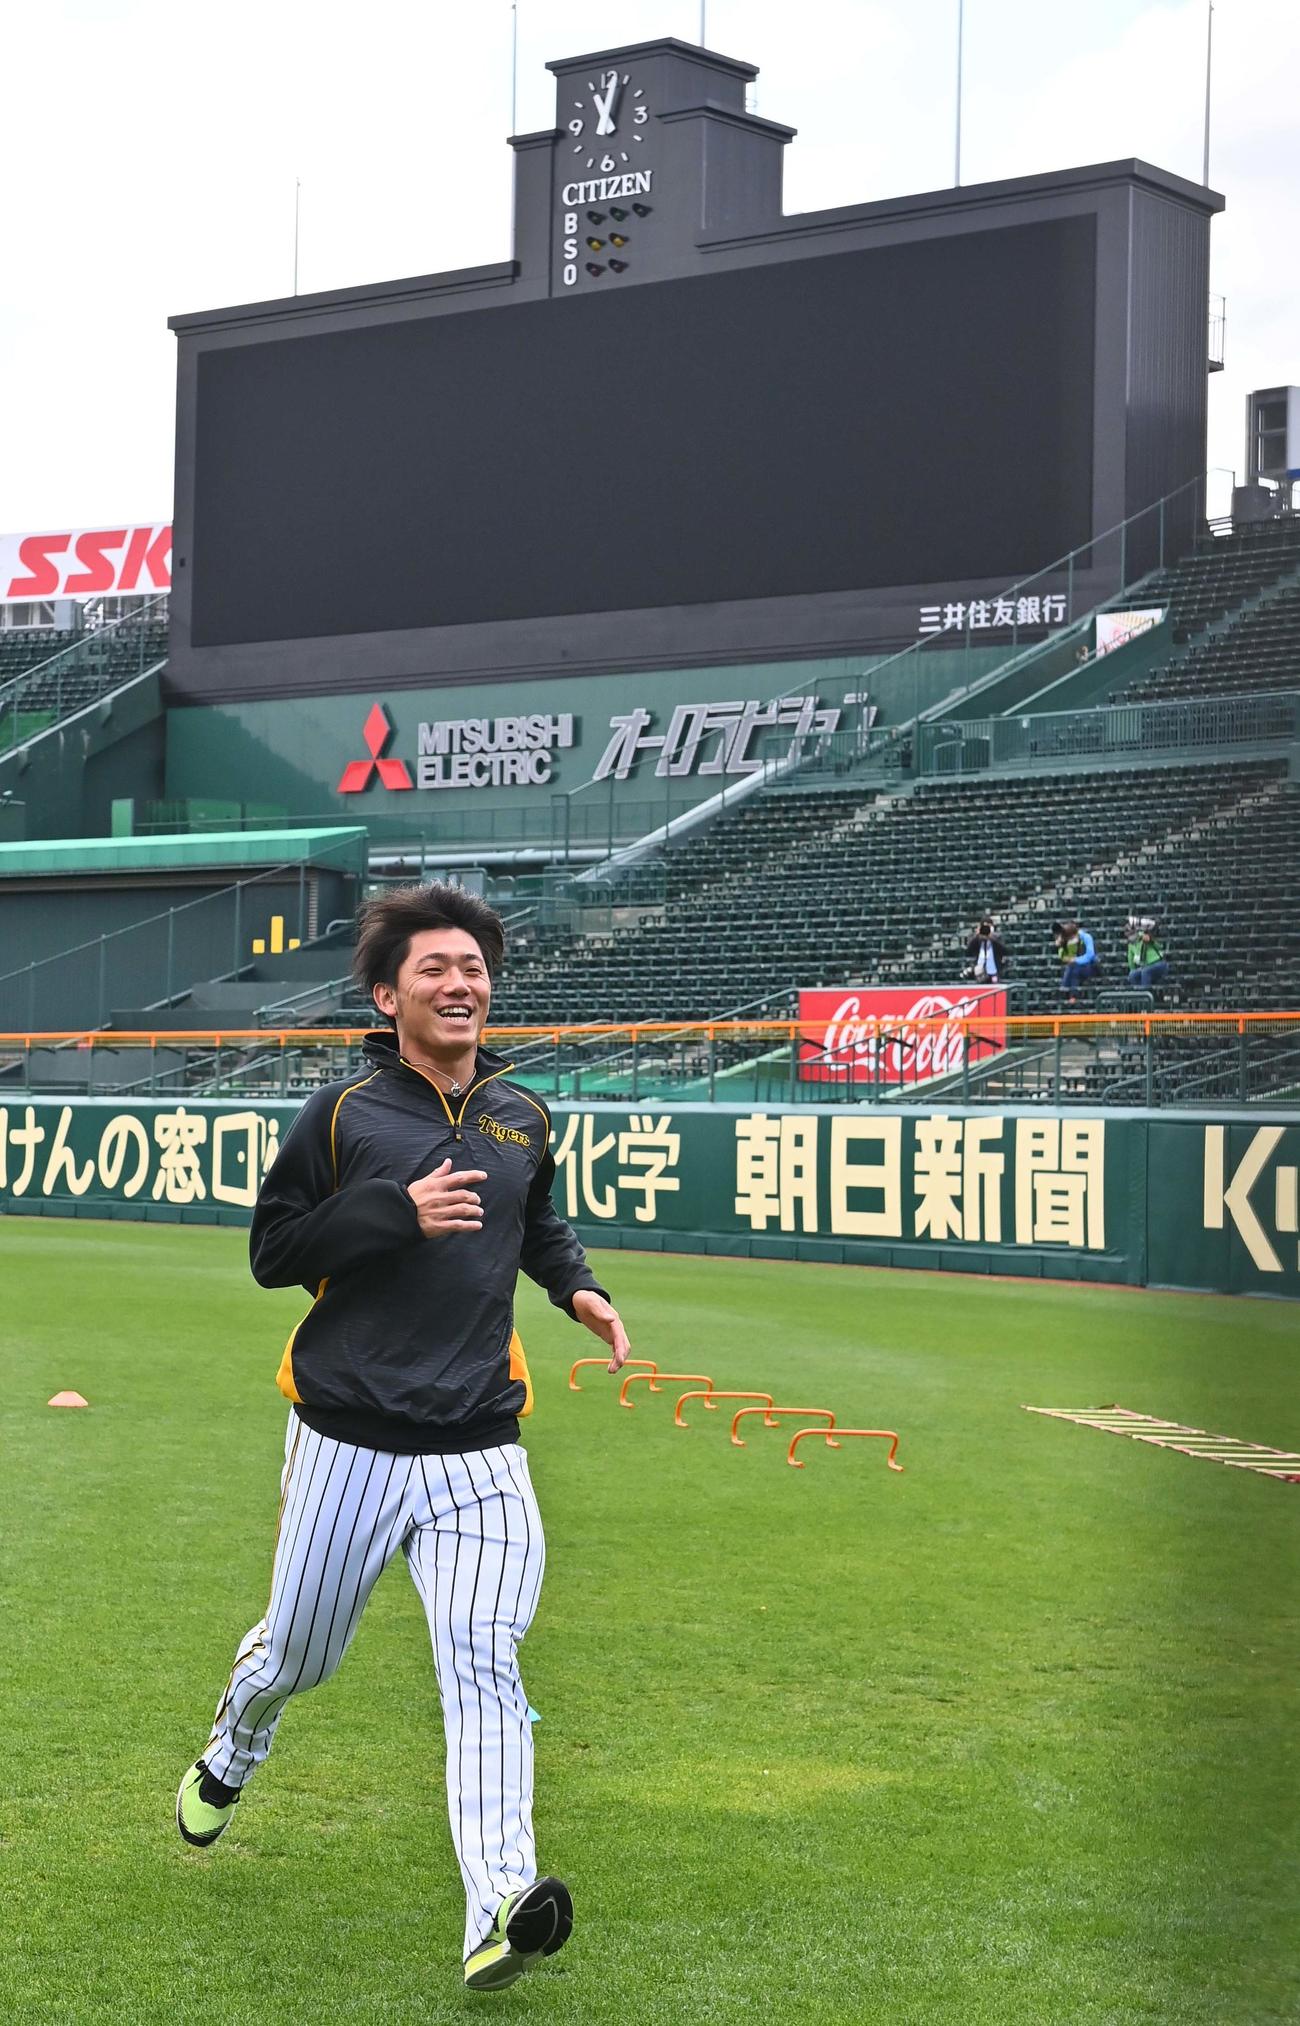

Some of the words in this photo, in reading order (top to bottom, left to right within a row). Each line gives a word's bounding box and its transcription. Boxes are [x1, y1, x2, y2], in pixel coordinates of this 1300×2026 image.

[568, 119, 584, 136] 9
[633, 106, 648, 124] 3
[600, 155, 615, 172] 6
[562, 171, 652, 206] CITIZEN
[564, 213, 578, 234] B
[563, 239, 578, 260] S
[6, 526, 173, 597] SSK
[918, 594, 1067, 633] 三井住友銀行
[417, 713, 573, 756] MITSUBISHI
[417, 749, 552, 790] ELECTRIC
[479, 1114, 530, 1147] Tigers
[549, 1113, 681, 1222] 化学
[735, 1113, 1105, 1250] 朝日新聞
